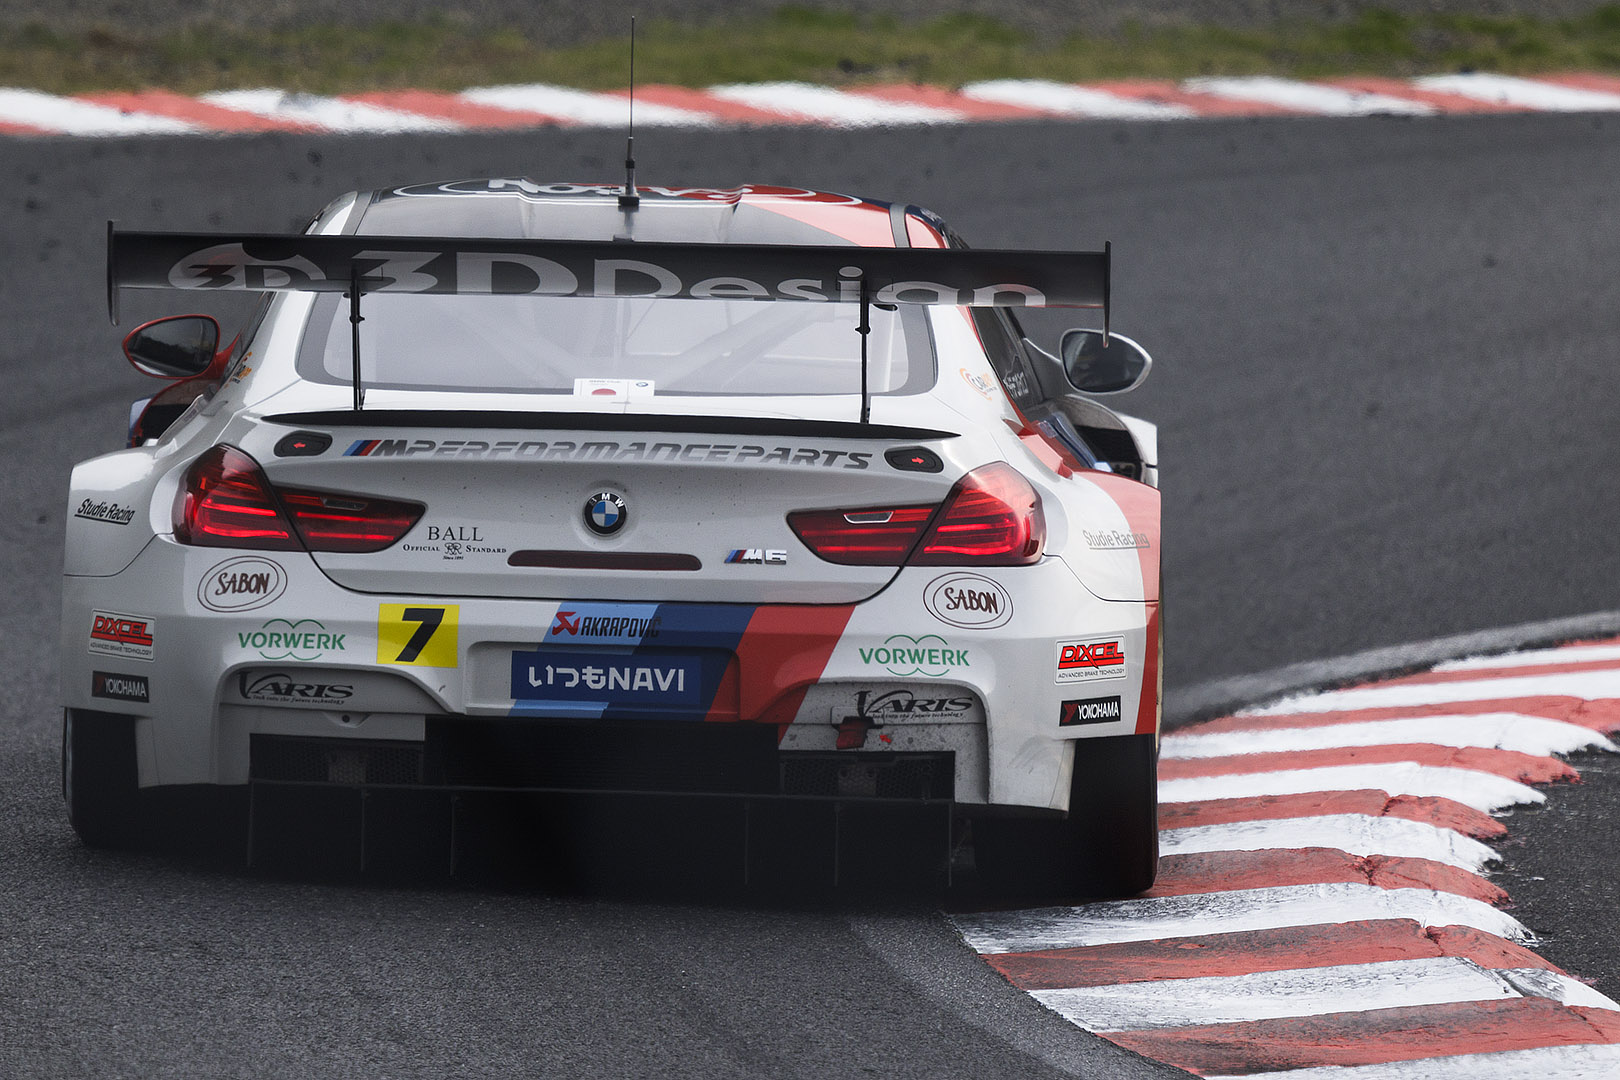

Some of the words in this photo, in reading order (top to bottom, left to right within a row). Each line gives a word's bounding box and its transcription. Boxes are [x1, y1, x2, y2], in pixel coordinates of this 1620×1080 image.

[735, 445, 873, 470] PARTS
[77, 498, 108, 518] Studie
[105, 503, 135, 522] Racing
[589, 493, 625, 508] BMW
[427, 526, 483, 541] BALL
[1082, 530, 1115, 547] Studie
[1111, 530, 1150, 548] Racing
[741, 549, 787, 565] M6
[215, 571, 270, 596] SABON
[944, 587, 999, 615] SABON
[91, 615, 153, 642] DIXCEL
[394, 608, 446, 662] 7
[238, 631, 346, 651] VORWERK
[1059, 641, 1124, 664] DIXCEL
[858, 647, 970, 666] VORWERK
[527, 664, 685, 692] いつもNAVI
[1099, 668, 1125, 676] TECHNOLOGY
[104, 678, 147, 697] YOKOHAMA
[238, 671, 354, 699] VARIS
[854, 690, 973, 717] VARIS
[1077, 701, 1120, 720] YOKOHAMA
